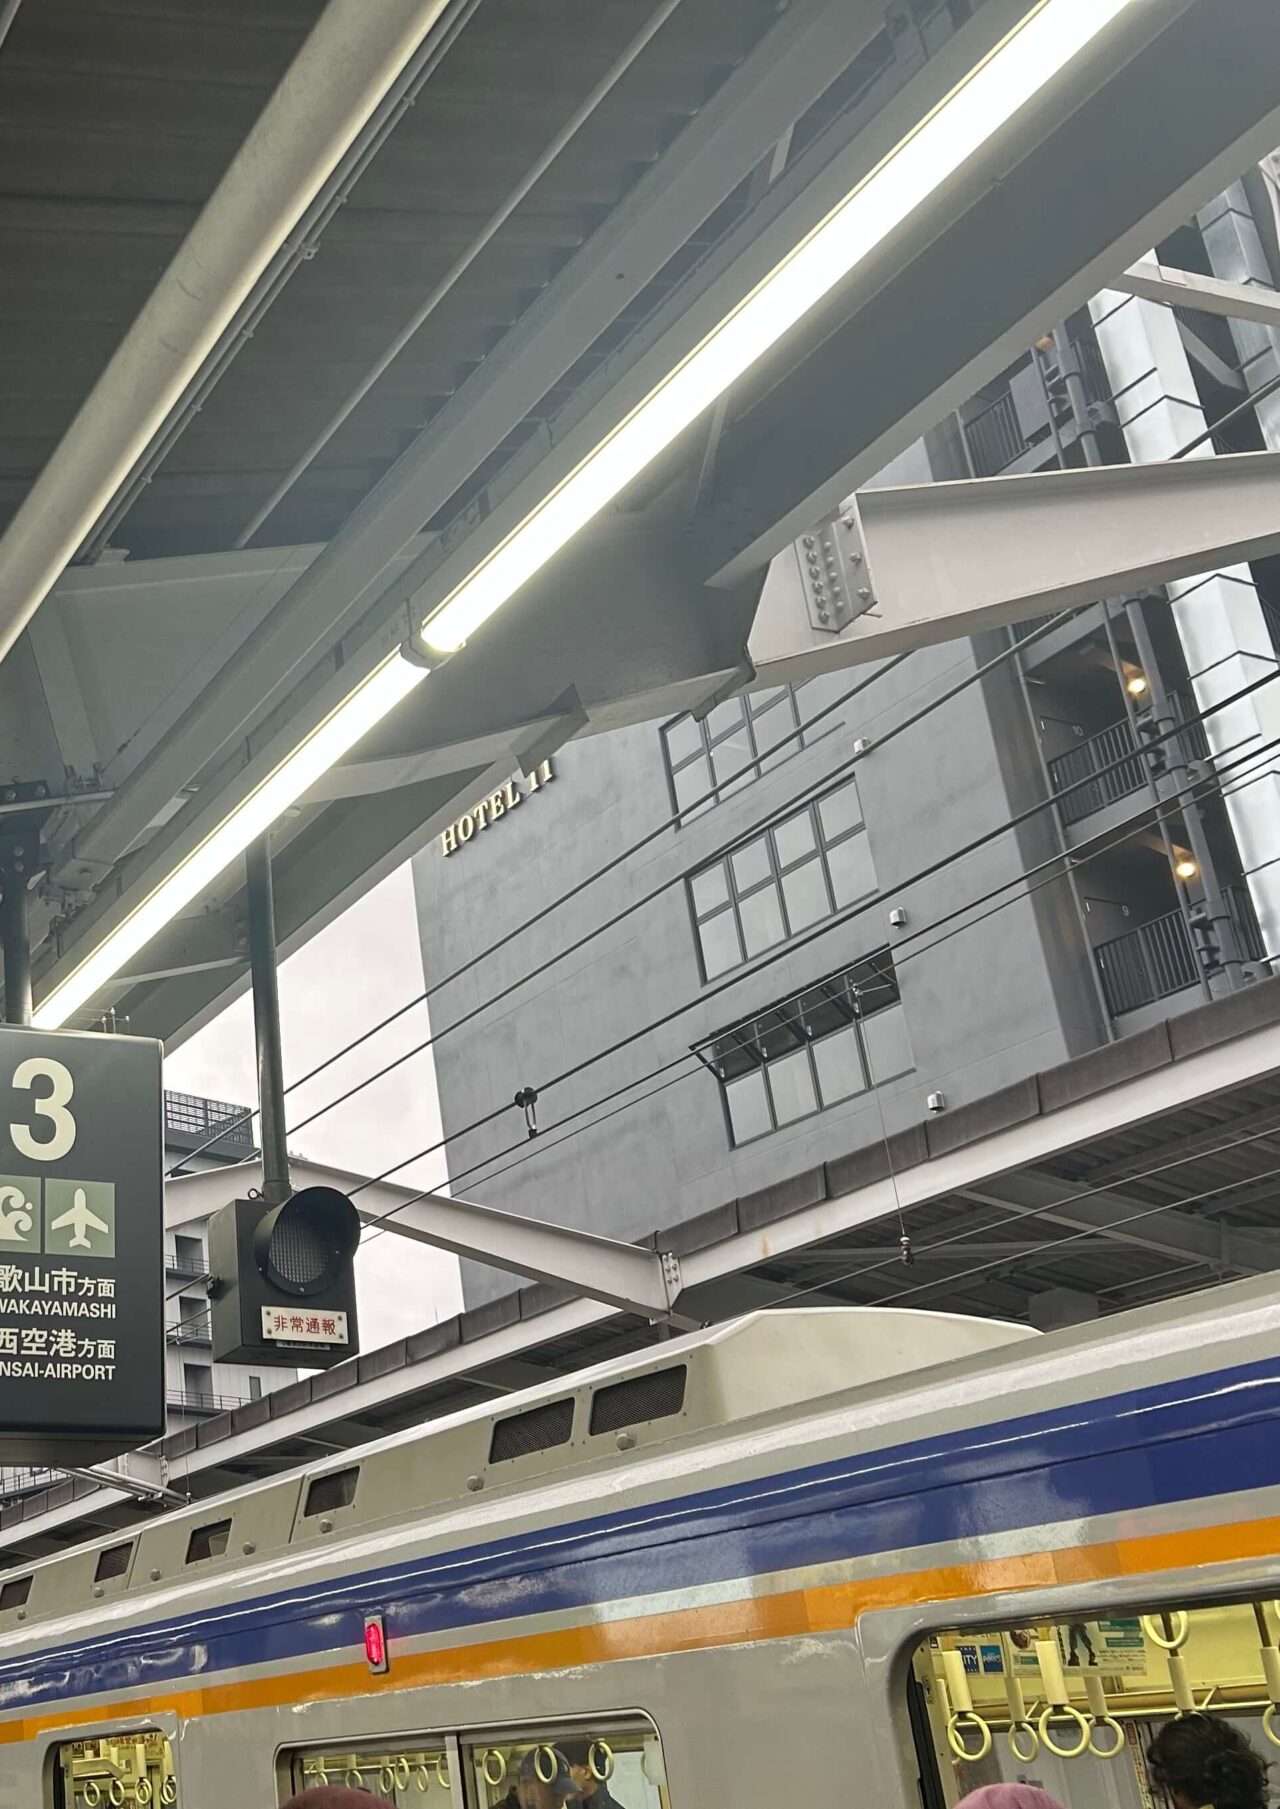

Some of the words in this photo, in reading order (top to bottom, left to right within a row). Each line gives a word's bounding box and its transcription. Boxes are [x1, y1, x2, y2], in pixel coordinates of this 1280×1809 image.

[440, 782, 520, 857] HOTEL
[9, 1057, 77, 1162] 3
[273, 1315, 336, 1336] 非常通報
